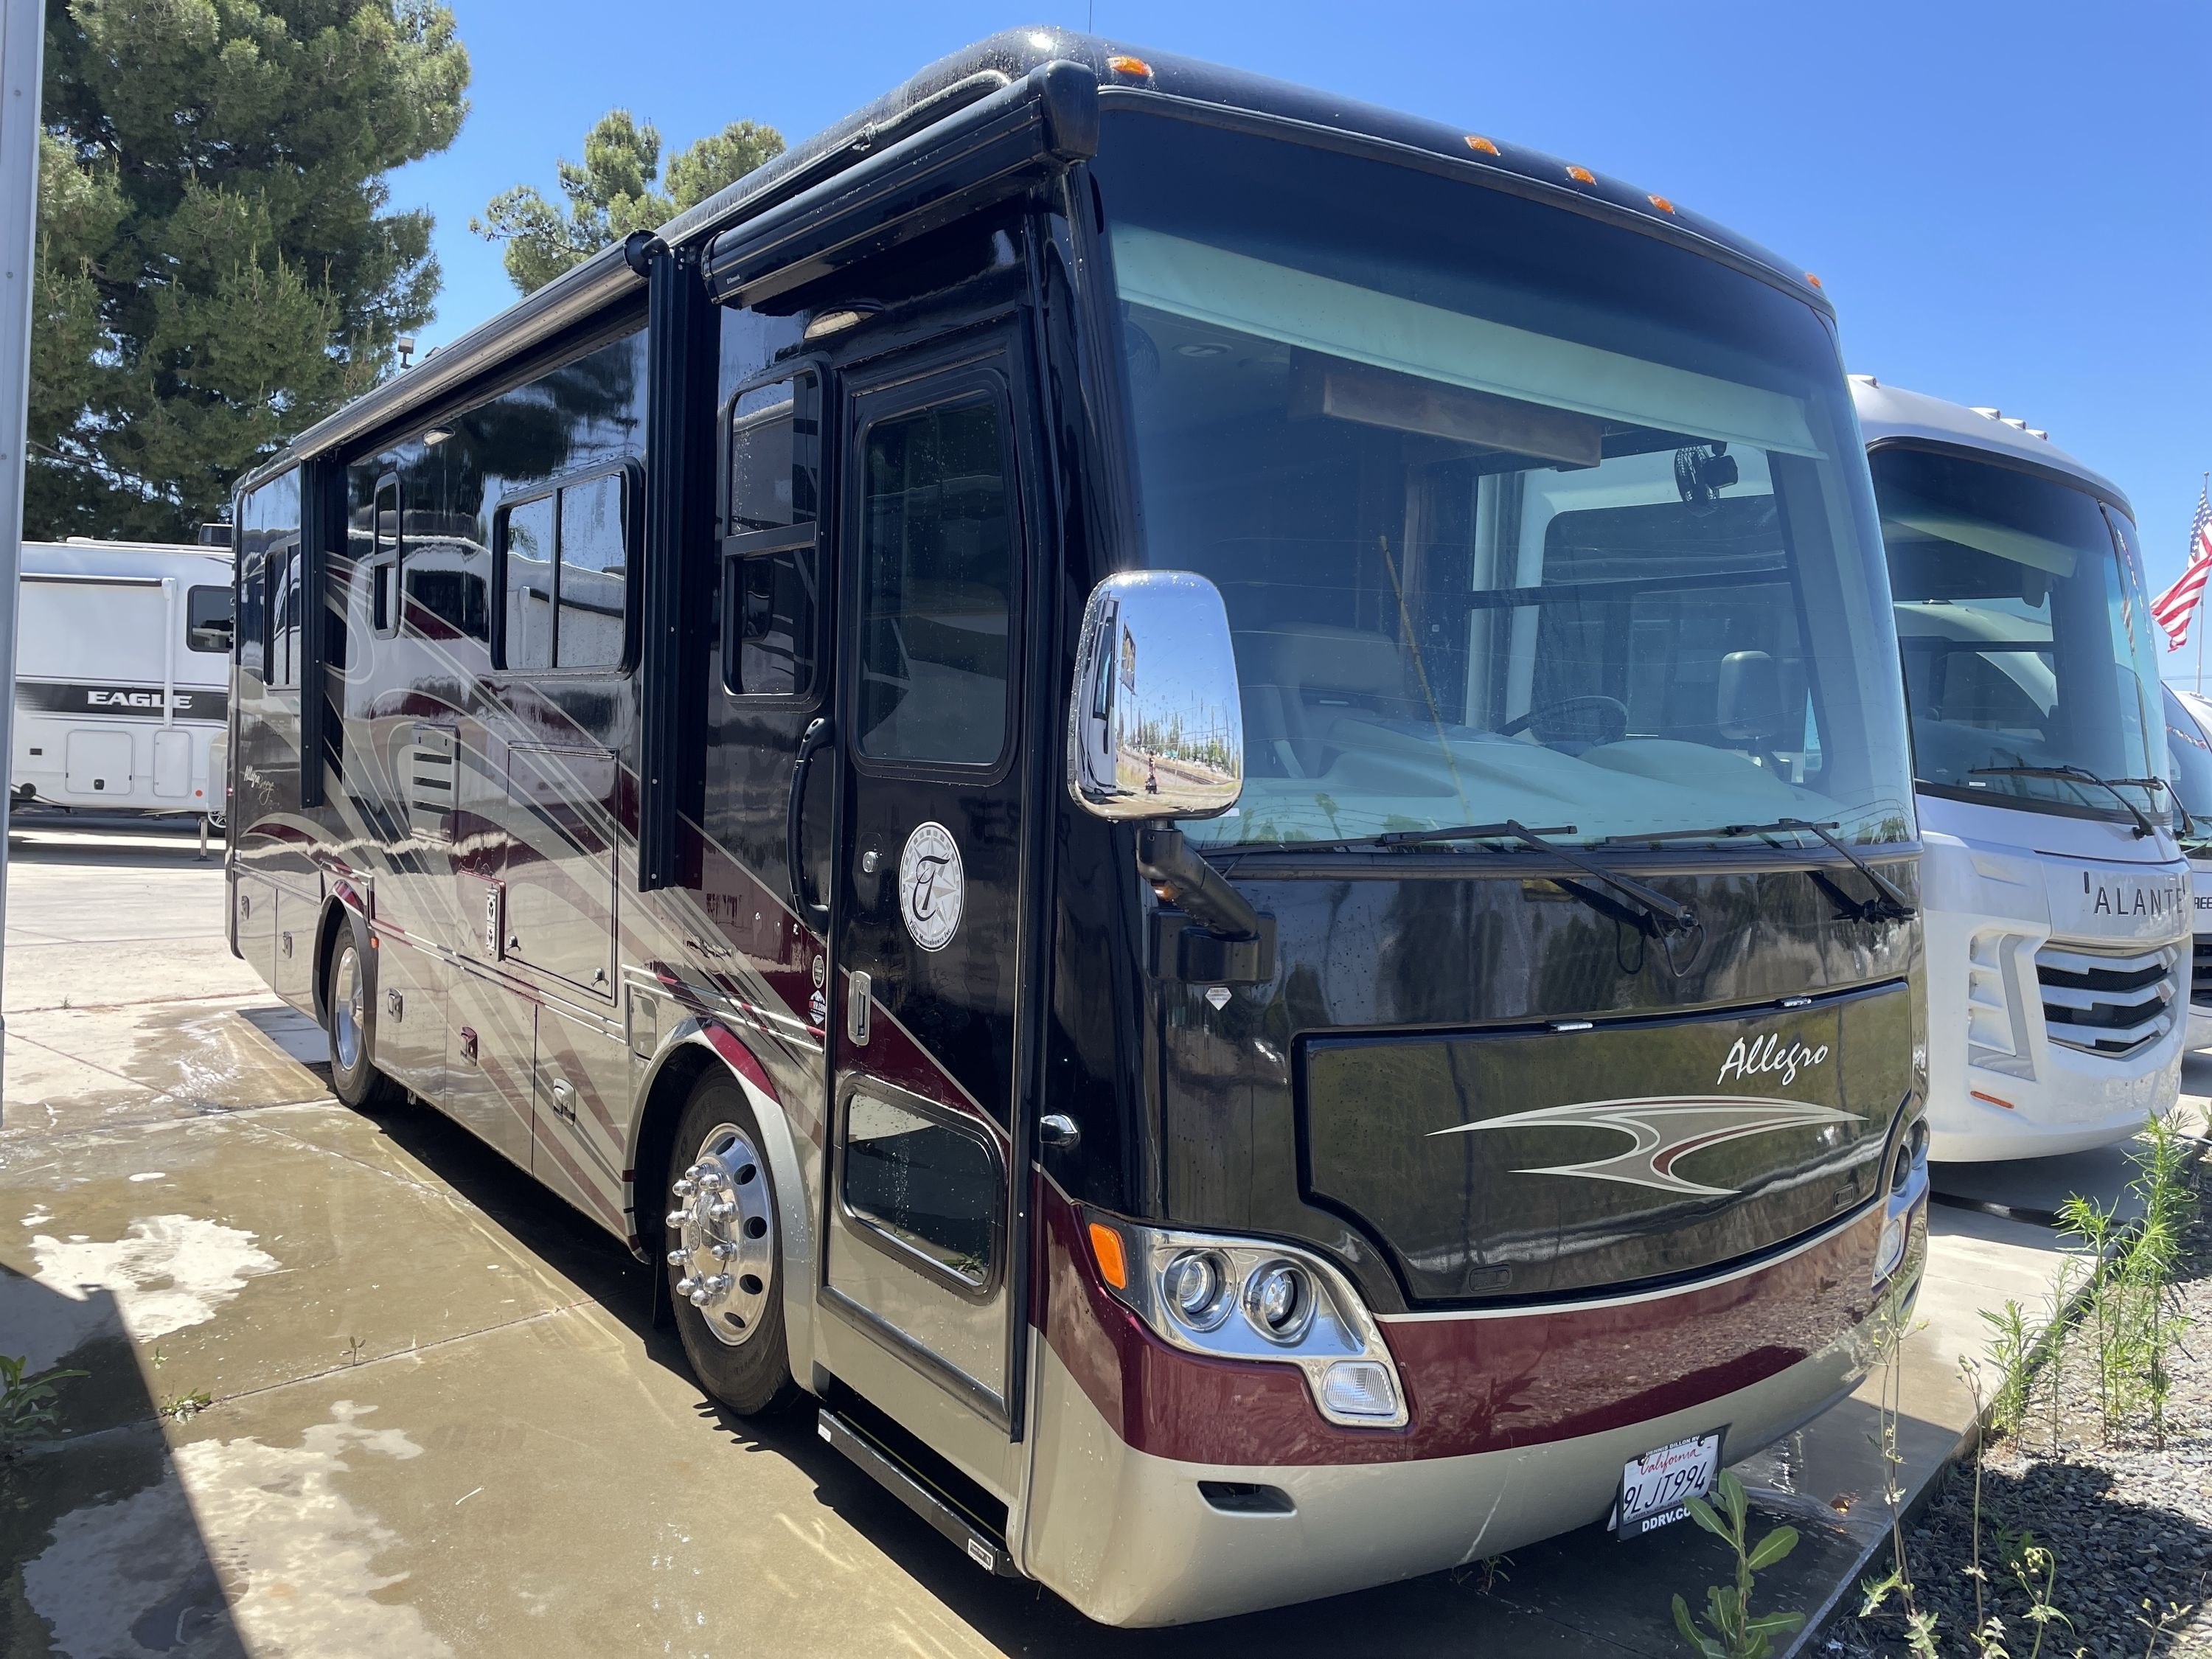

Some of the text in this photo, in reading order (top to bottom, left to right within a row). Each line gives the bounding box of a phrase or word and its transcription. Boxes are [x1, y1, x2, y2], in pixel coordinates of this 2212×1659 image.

[87, 690, 192, 709] EAGLE
[2094, 886, 2183, 916] ALANTE
[1717, 1033, 1829, 1086] Allegro
[1646, 1445, 1669, 1456] DENNIS
[1669, 1437, 1691, 1449] DILLON
[1640, 1447, 1703, 1475] California
[1624, 1461, 1707, 1514] 9LJT994
[1641, 1507, 1691, 1532] DDRV.CO
